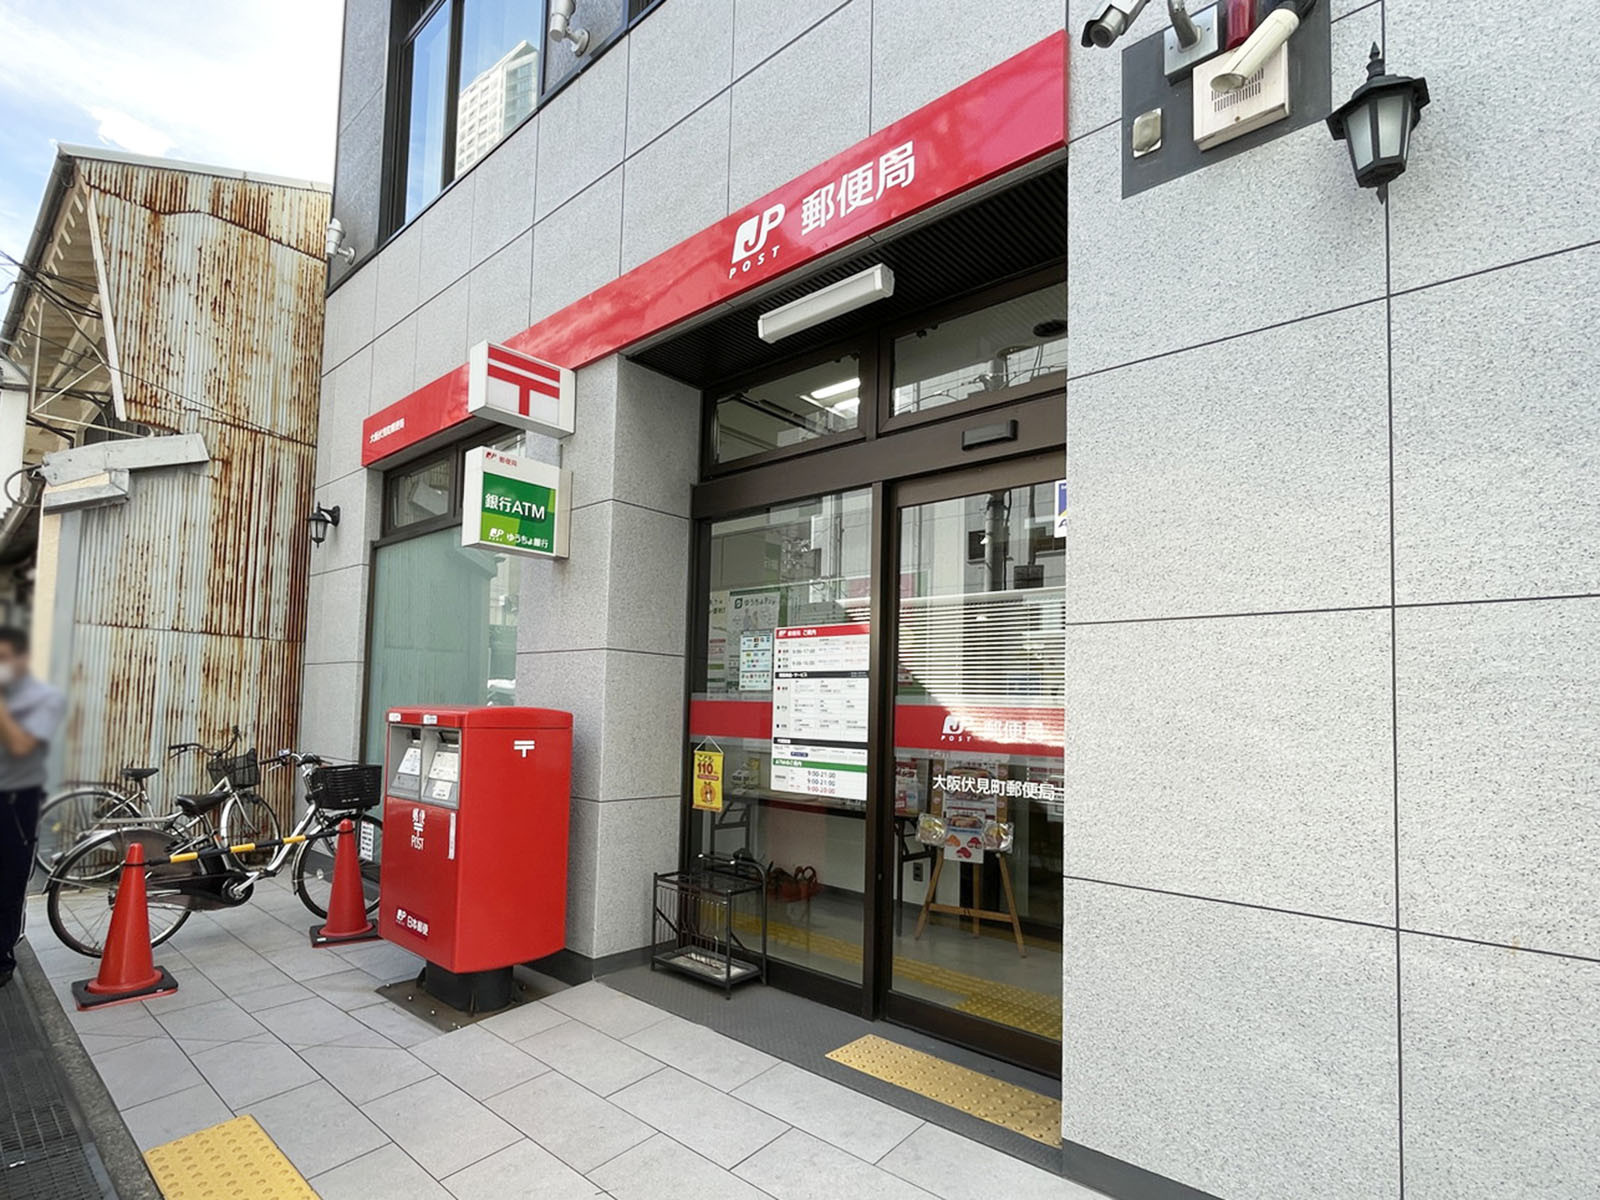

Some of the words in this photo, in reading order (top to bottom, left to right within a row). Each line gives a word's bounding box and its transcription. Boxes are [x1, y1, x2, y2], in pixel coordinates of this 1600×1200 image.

[800, 140, 915, 236] 郵便局
[728, 245, 781, 280] POST
[485, 493, 546, 520] 銀行ATM
[506, 533, 549, 549] ゆうちょ銀行
[940, 735, 973, 743] POST
[932, 774, 1055, 800] 大阪伏見町郵便局
[411, 835, 425, 851] POST
